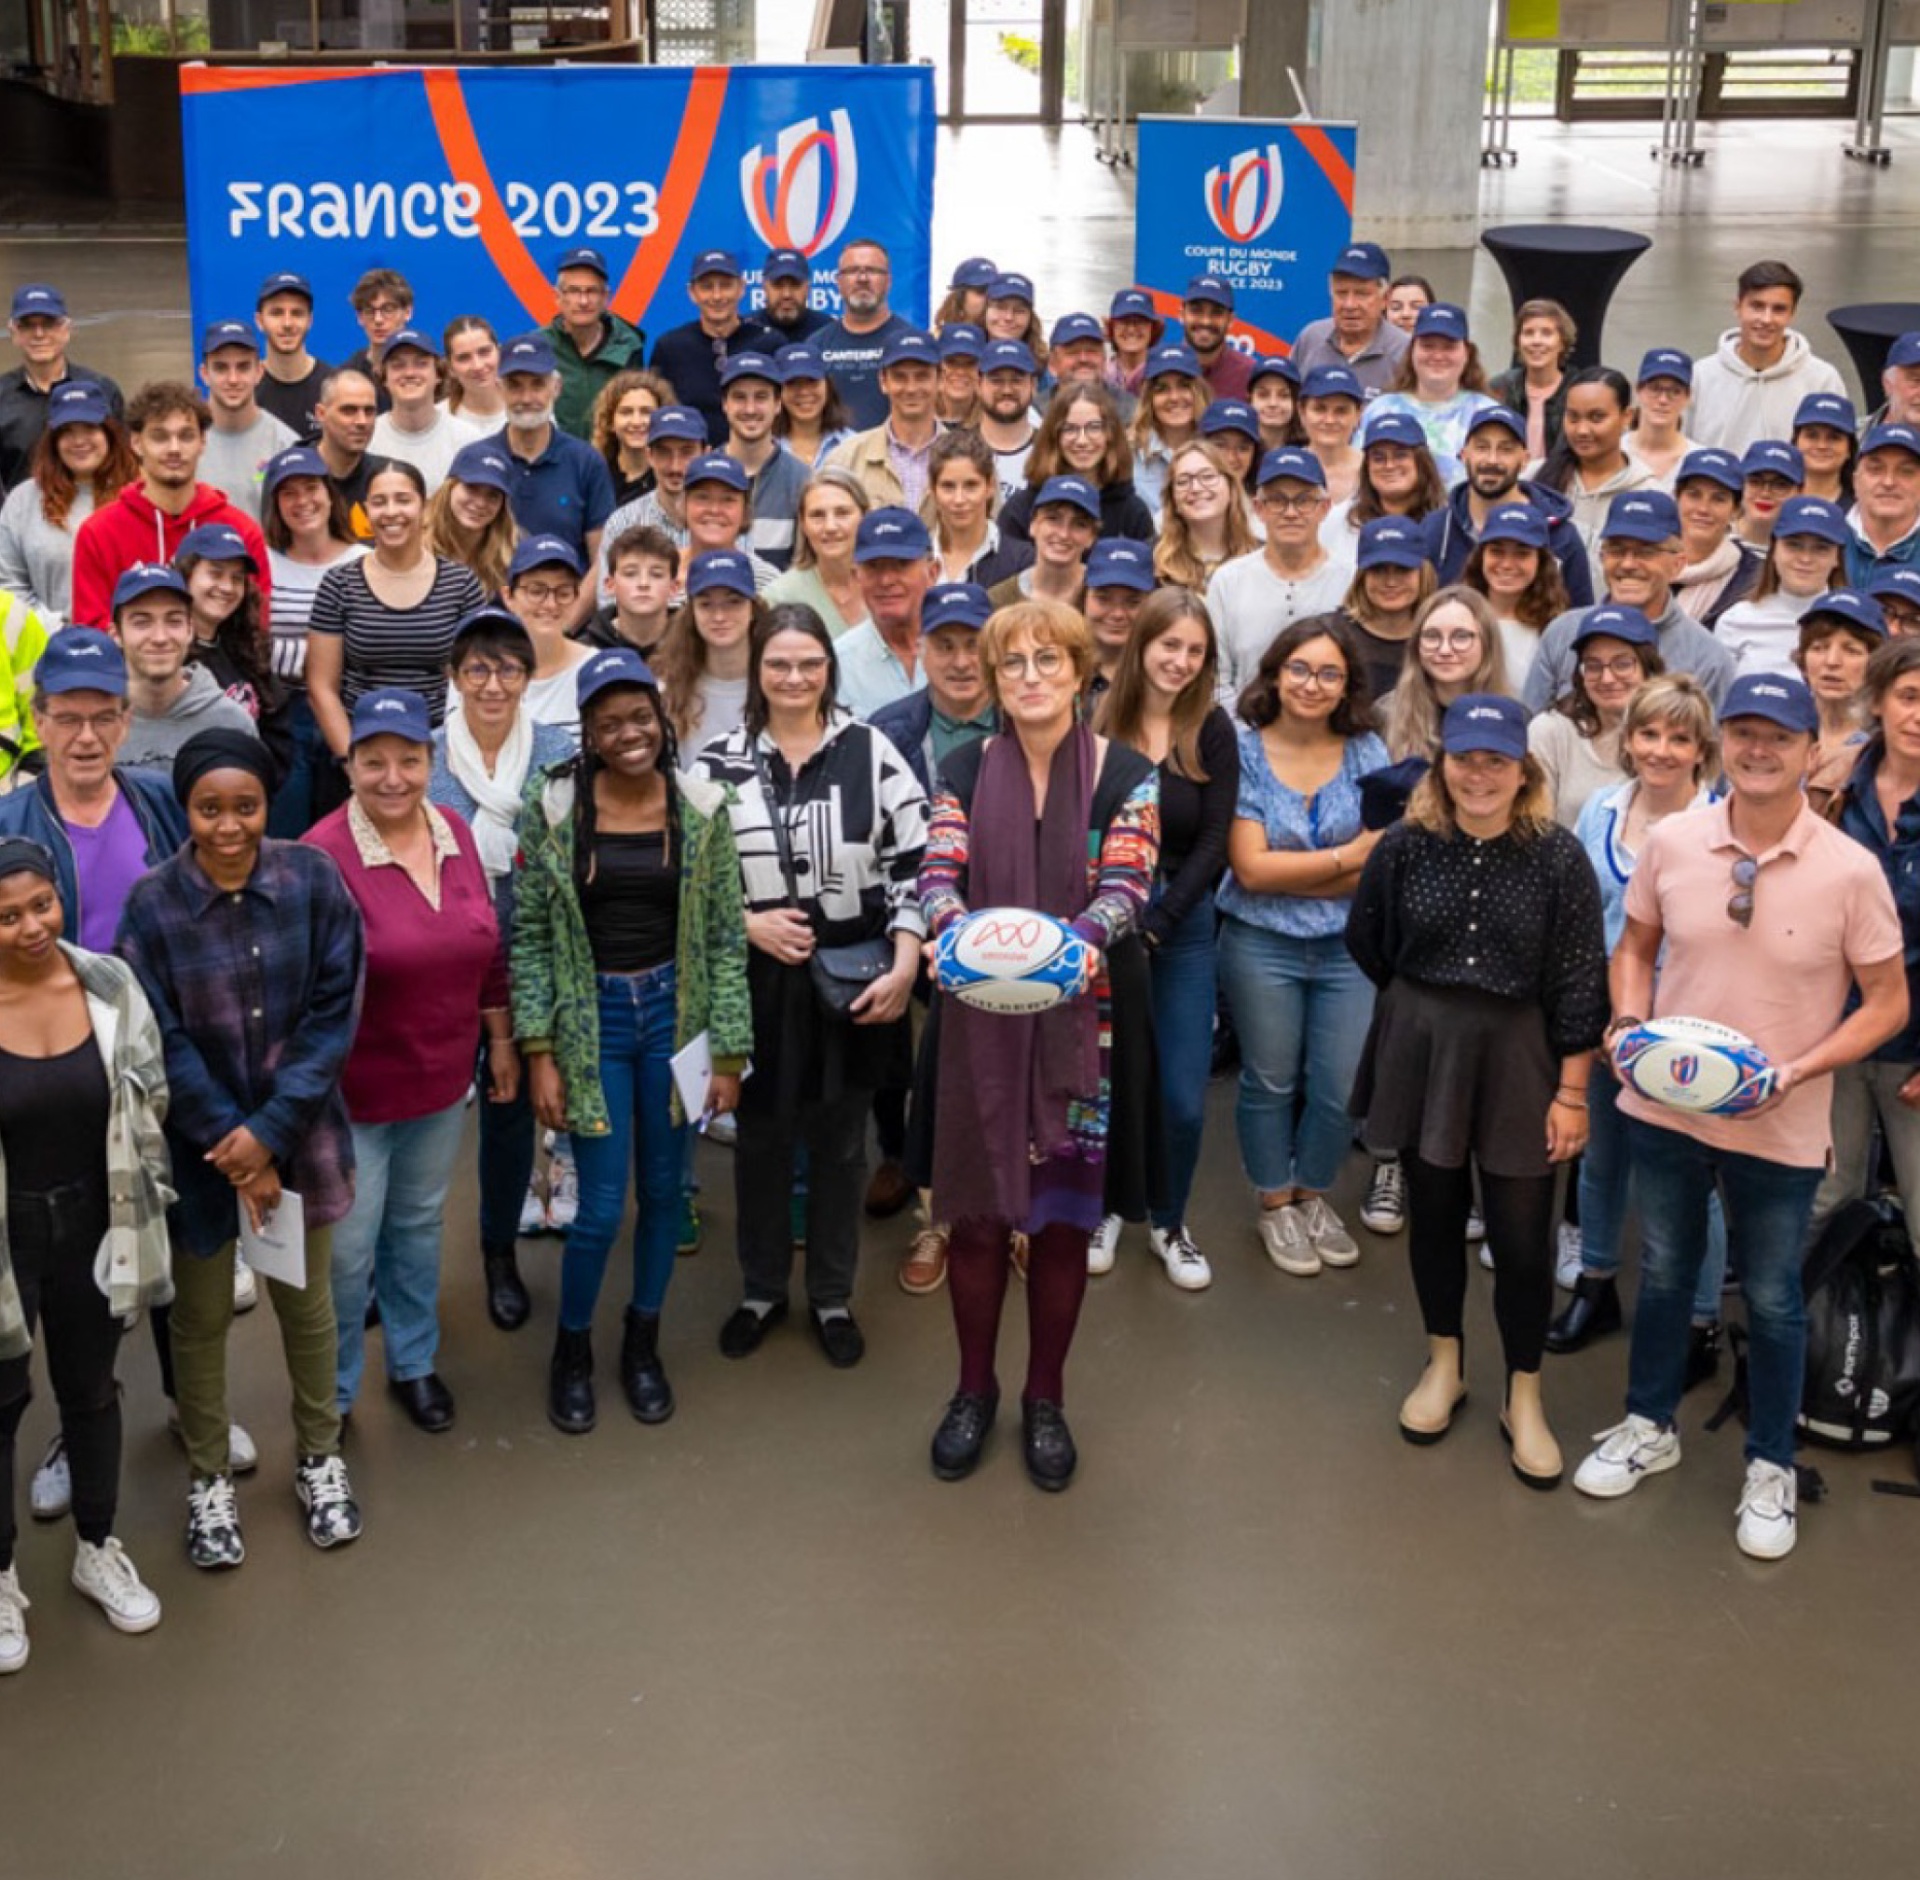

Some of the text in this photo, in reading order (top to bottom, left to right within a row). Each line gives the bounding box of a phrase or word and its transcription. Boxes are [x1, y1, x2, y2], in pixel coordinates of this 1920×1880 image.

[506, 181, 660, 237] 2023
[1184, 244, 1298, 262] COUPE DU MONDE
[1207, 258, 1273, 276] RUGBY
[1249, 277, 1284, 291] 2023
[751, 287, 842, 311] RBY
